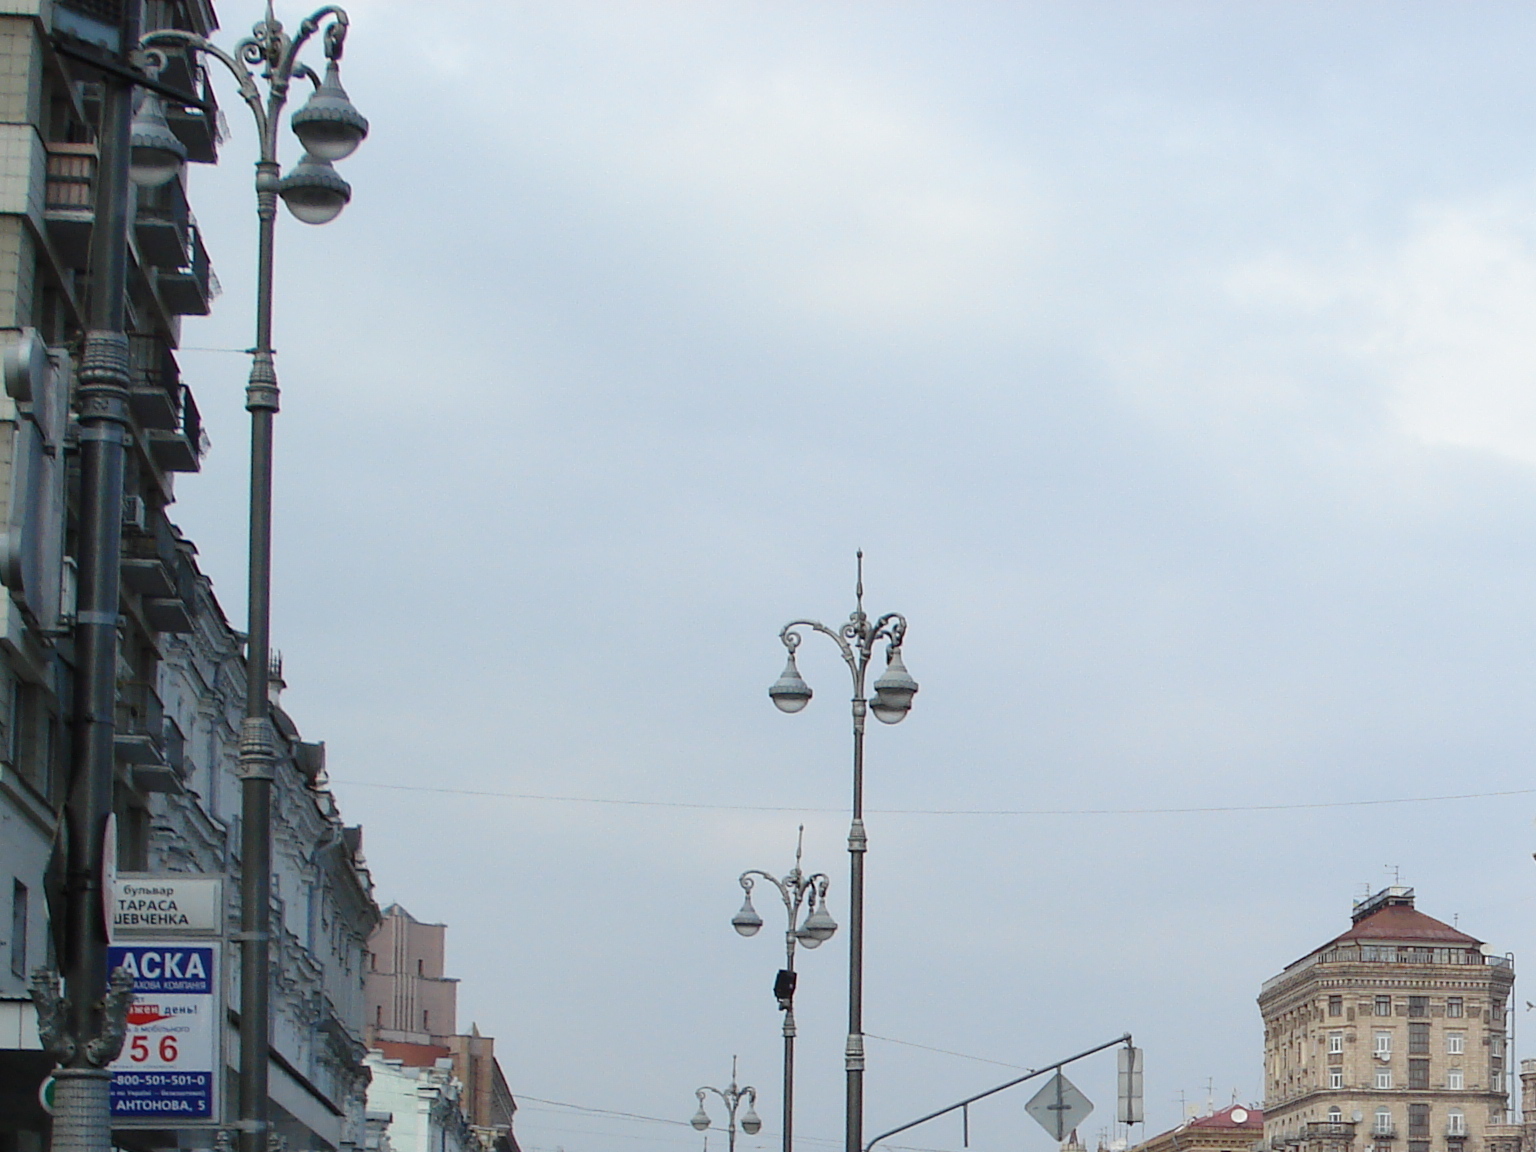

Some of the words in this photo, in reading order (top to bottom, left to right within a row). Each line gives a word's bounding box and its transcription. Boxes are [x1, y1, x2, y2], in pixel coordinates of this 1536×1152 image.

[124, 885, 174, 896] бульвар
[118, 900, 178, 911] ТАРАСА
[121, 952, 206, 979] АСКА
[164, 1005, 198, 1015] день!
[198, 1100, 206, 1111] 5
